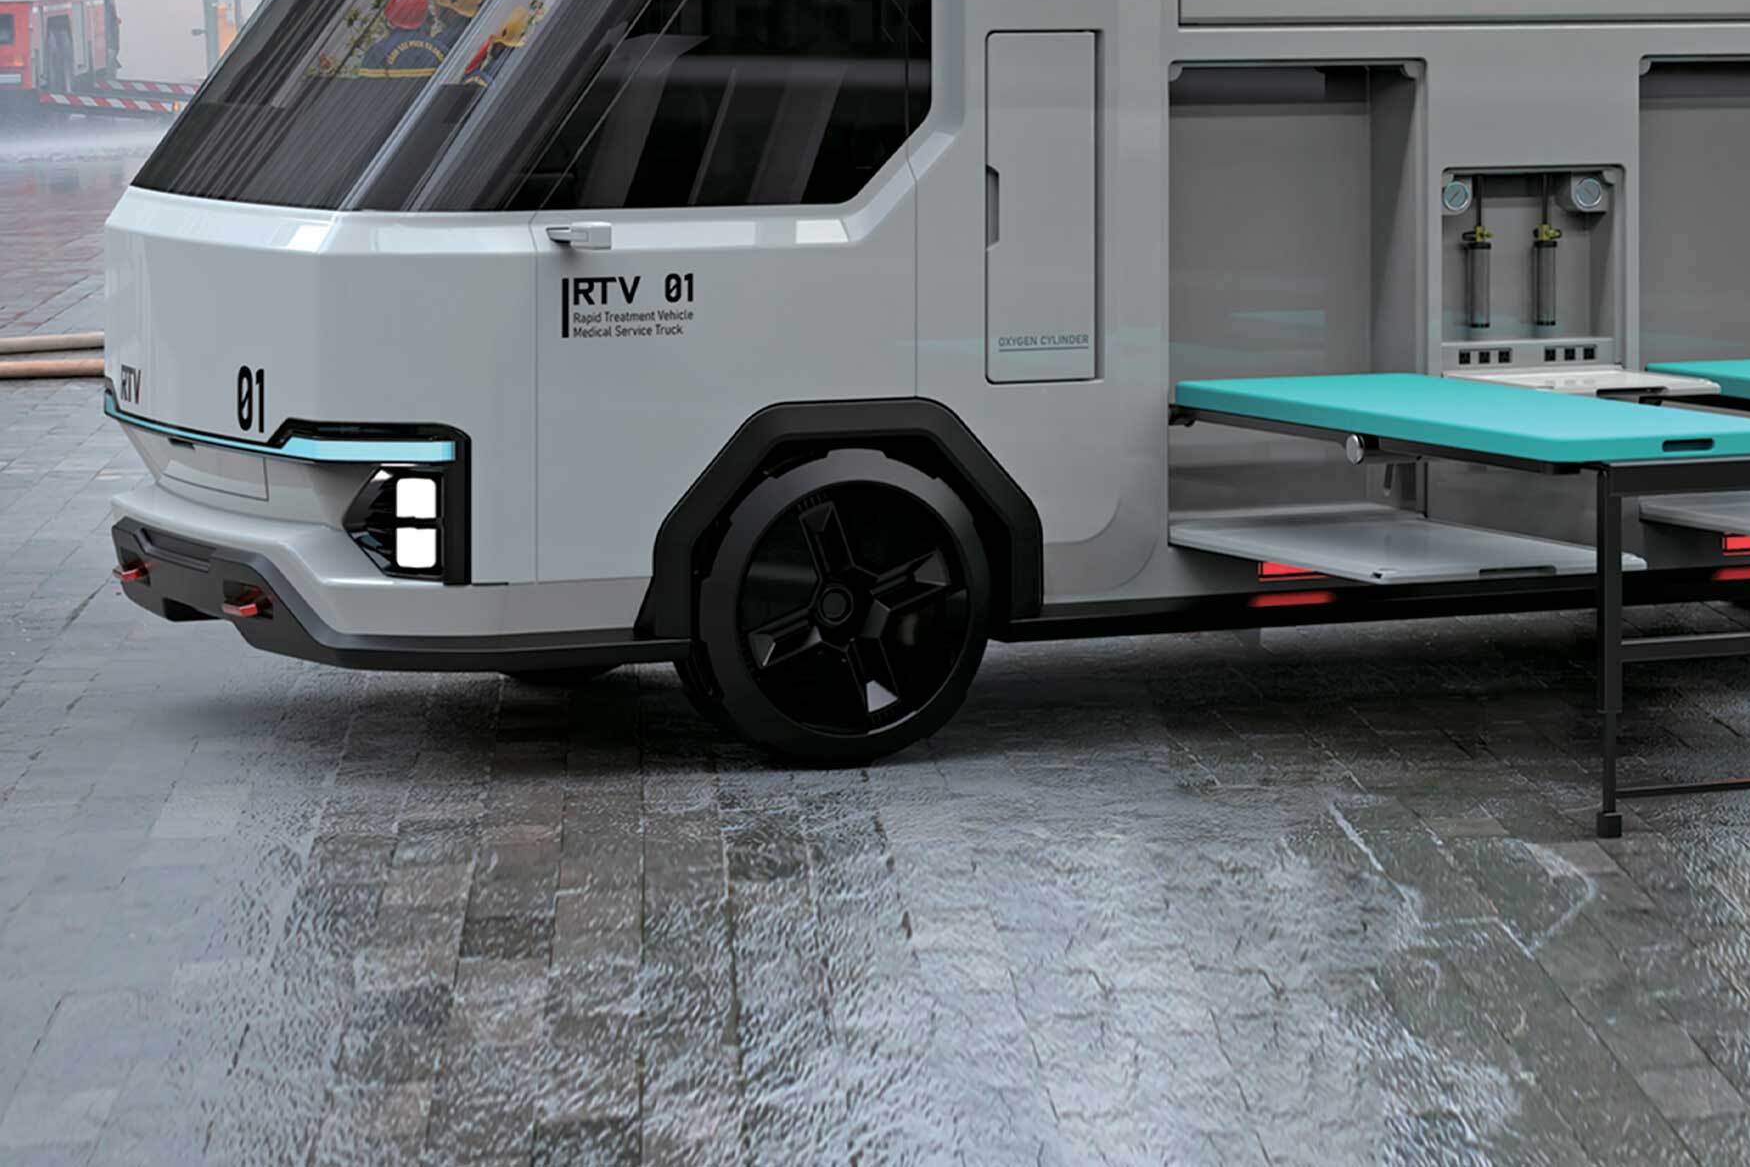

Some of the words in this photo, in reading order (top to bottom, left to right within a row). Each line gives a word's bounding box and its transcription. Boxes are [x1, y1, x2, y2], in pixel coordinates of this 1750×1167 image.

[573, 276, 641, 305] RTV
[665, 273, 694, 303] 01
[573, 312, 602, 325] Rapid
[604, 311, 655, 323] Treatment
[657, 309, 694, 321] Vehicle
[573, 326, 612, 338] Medical
[614, 325, 653, 337] Service
[655, 324, 684, 335] Truck
[998, 336, 1038, 347] OXYGEN
[1040, 334, 1089, 346] CYLINDER
[120, 364, 141, 404] RTV
[237, 364, 264, 434] 01
